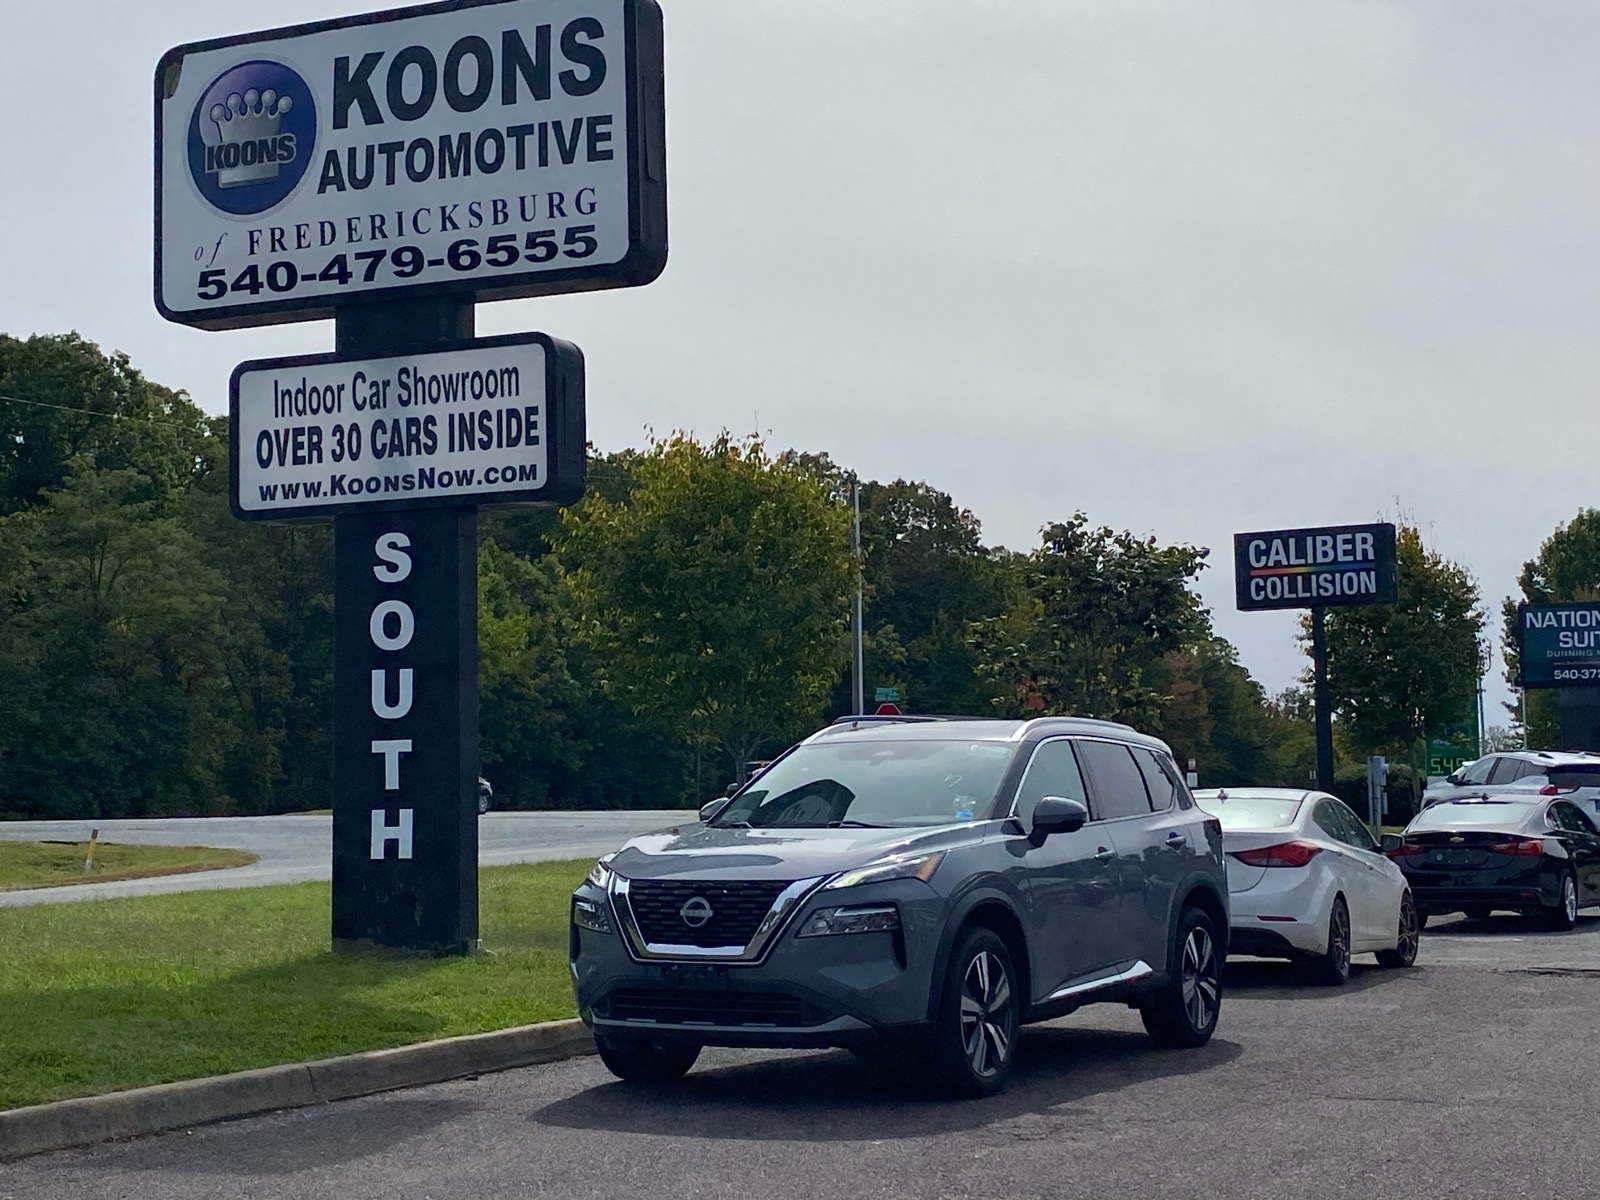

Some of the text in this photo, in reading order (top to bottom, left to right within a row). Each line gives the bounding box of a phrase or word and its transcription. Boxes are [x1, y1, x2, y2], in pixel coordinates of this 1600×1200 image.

[332, 16, 607, 130] KOONS
[205, 132, 297, 173] KOONS
[317, 114, 614, 195] AUTOMOTIVE
[194, 187, 598, 269] of FREDERICKSBURG
[197, 225, 598, 301] 540-479-6555
[273, 366, 519, 418] Indoor Car Showroom
[256, 406, 540, 469] OVER 30 CARS INSIDE
[1249, 532, 1376, 568] CALIBER
[1250, 571, 1377, 601] COLLISION
[1546, 649, 1594, 658] DUNNING
[369, 531, 415, 860] SOUTH
